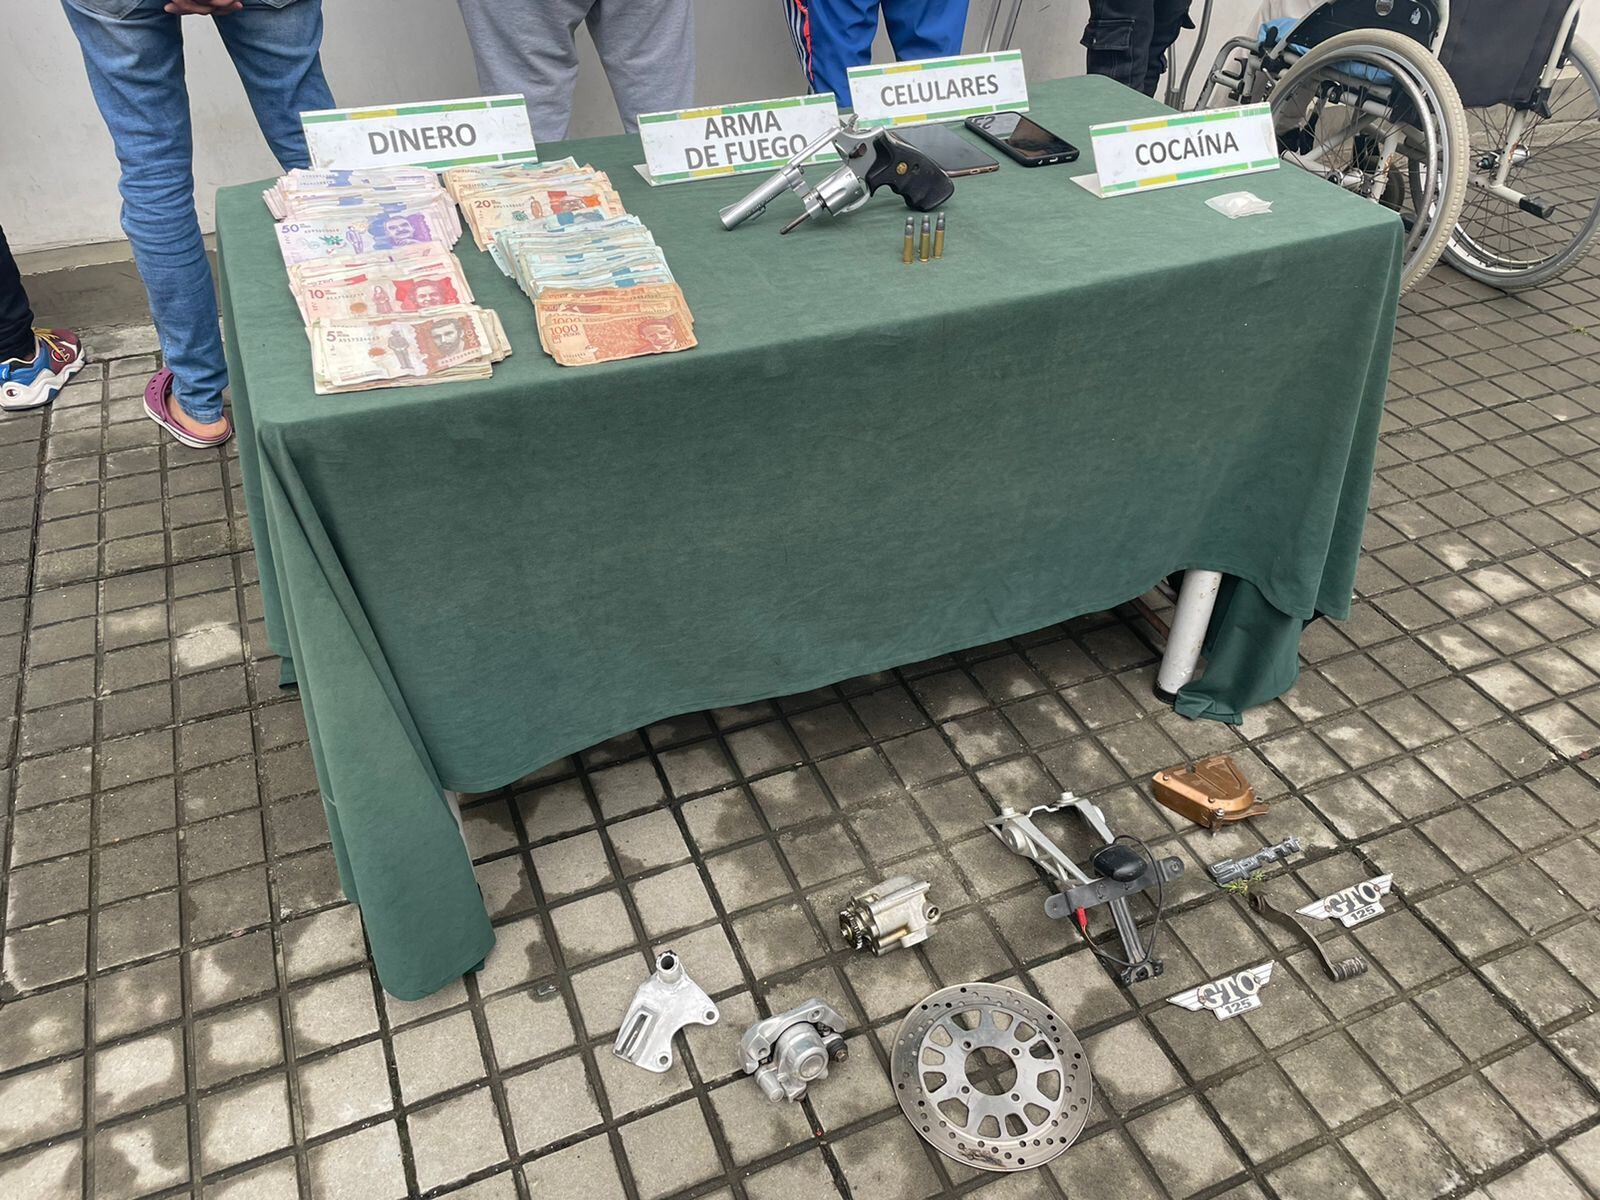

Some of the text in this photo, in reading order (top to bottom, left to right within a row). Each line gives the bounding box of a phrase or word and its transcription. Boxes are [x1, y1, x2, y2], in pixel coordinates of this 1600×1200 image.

[880, 74, 999, 107] CELULARES
[704, 111, 782, 140] ARMA
[368, 123, 477, 155] DINERO
[1135, 130, 1240, 166] COCAÍNA
[684, 134, 808, 170] DE FUEGO
[474, 200, 491, 209] 20
[281, 223, 299, 233] 50
[309, 289, 325, 300] 10
[326, 331, 336, 342] 5
[550, 325, 579, 336] 1000
[1326, 881, 1381, 918] GTO
[1350, 906, 1376, 922] 125
[1198, 971, 1258, 1009] GTO
[1225, 1000, 1252, 1016] 125
